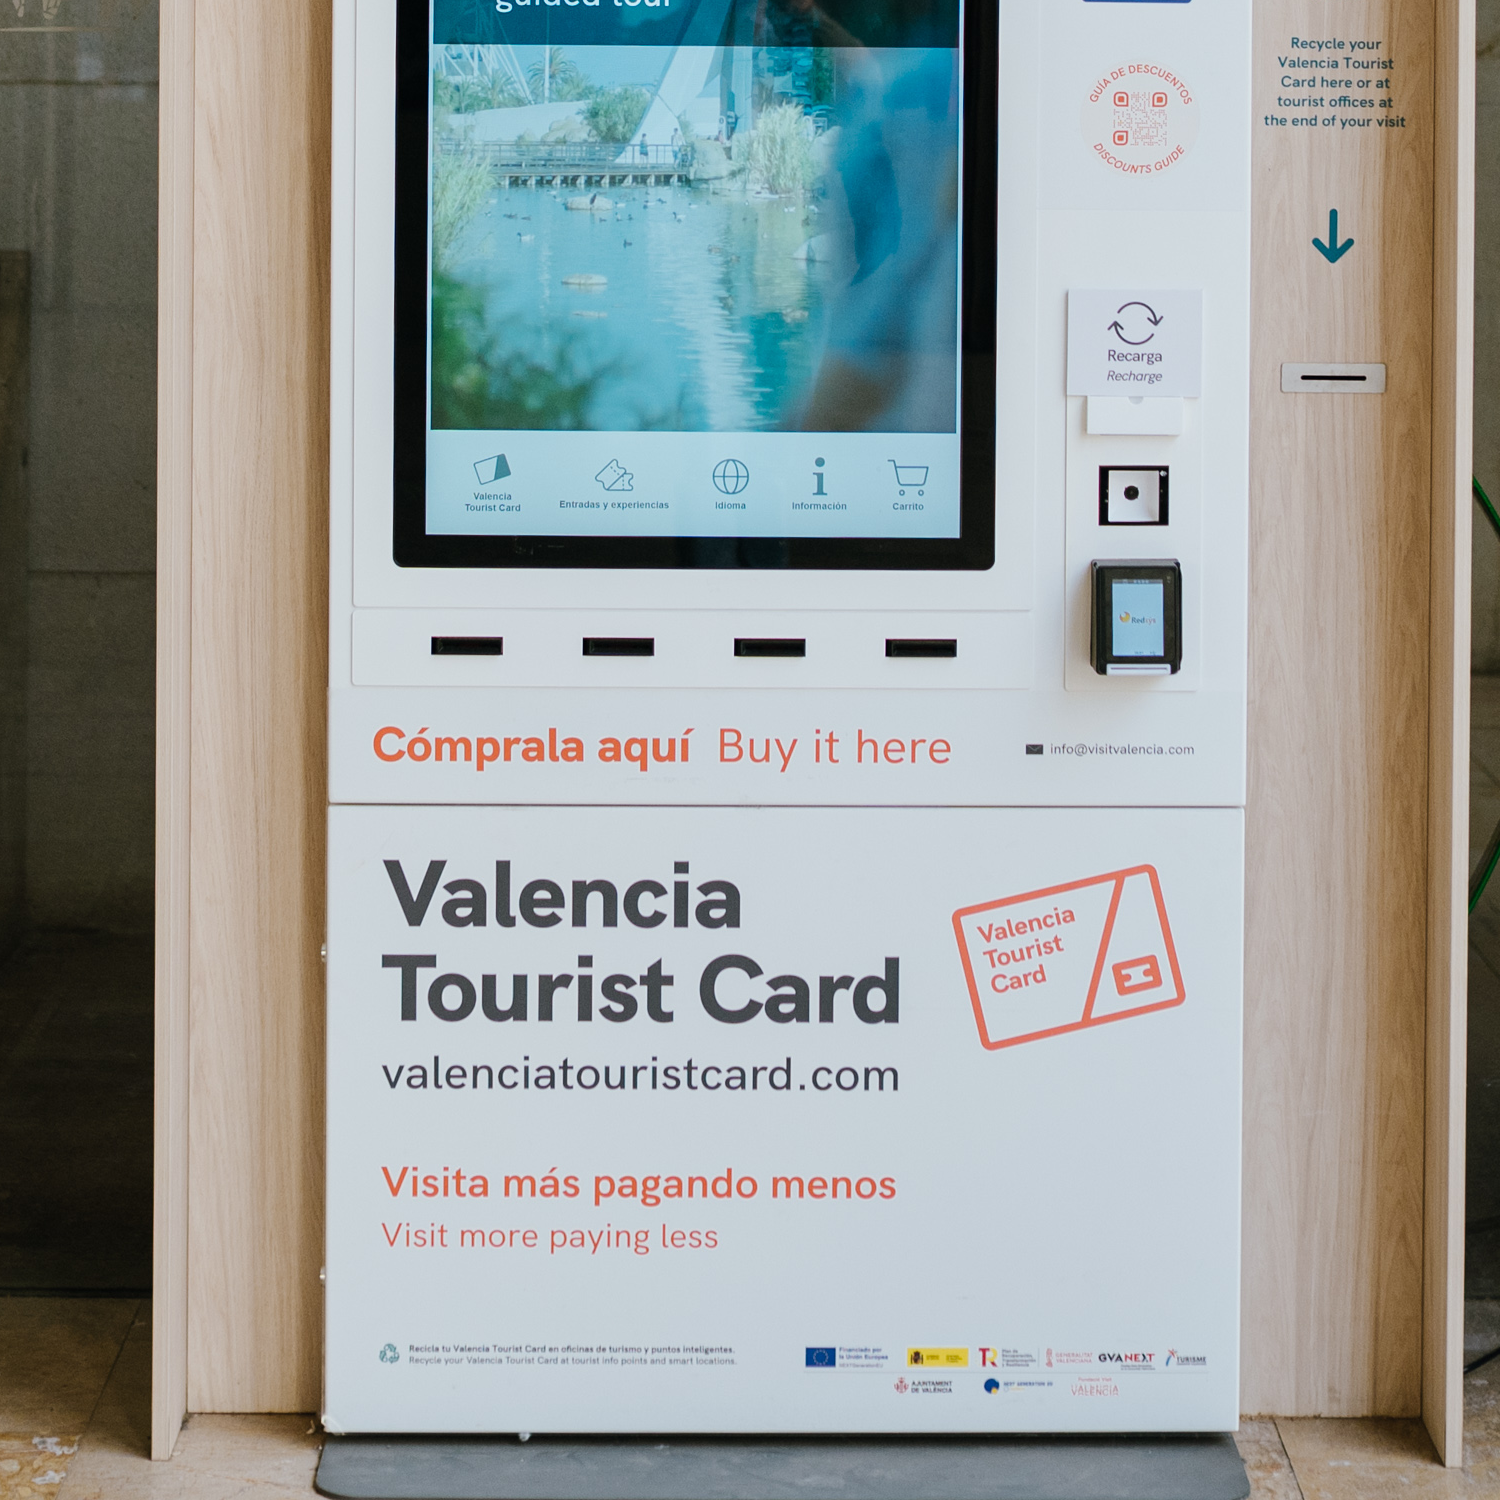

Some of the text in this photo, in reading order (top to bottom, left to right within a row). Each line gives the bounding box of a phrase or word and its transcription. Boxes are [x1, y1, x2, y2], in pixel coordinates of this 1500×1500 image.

[1290, 36, 1383, 53] Recycle your
[1277, 56, 1394, 70] Valencia Tourist
[1089, 64, 1193, 105] GUÍA DE DESCUENTOS
[1280, 75, 1391, 90] Card here or at
[1277, 95, 1394, 109] tourist offices at
[1263, 114, 1406, 131] the end of your visit
[1093, 142, 1185, 174] DISCOUNTS GUIDE
[1107, 349, 1163, 366] Recarga
[1106, 369, 1163, 385] Recharge
[473, 492, 512, 501] Valencia
[464, 503, 521, 512] Tourist Card
[559, 500, 670, 511] Entradas y experiencias
[715, 501, 747, 510] Idioma
[791, 501, 847, 511] Información
[892, 502, 925, 511] Carrito
[373, 726, 694, 772] Cómprala aquí
[720, 729, 951, 772] Buy it here
[1050, 743, 1195, 757] info@visitvalencia.com
[383, 860, 740, 929] Valencia
[976, 906, 1076, 944] Valencia
[982, 934, 1065, 969] Tourist
[990, 963, 1047, 994] Card
[382, 954, 899, 1024] Tourist Card
[382, 1056, 898, 1091] valenciatouristcard.com
[381, 1167, 896, 1207] Visita más pagando menos
[382, 1223, 717, 1255] Visit more paying less
